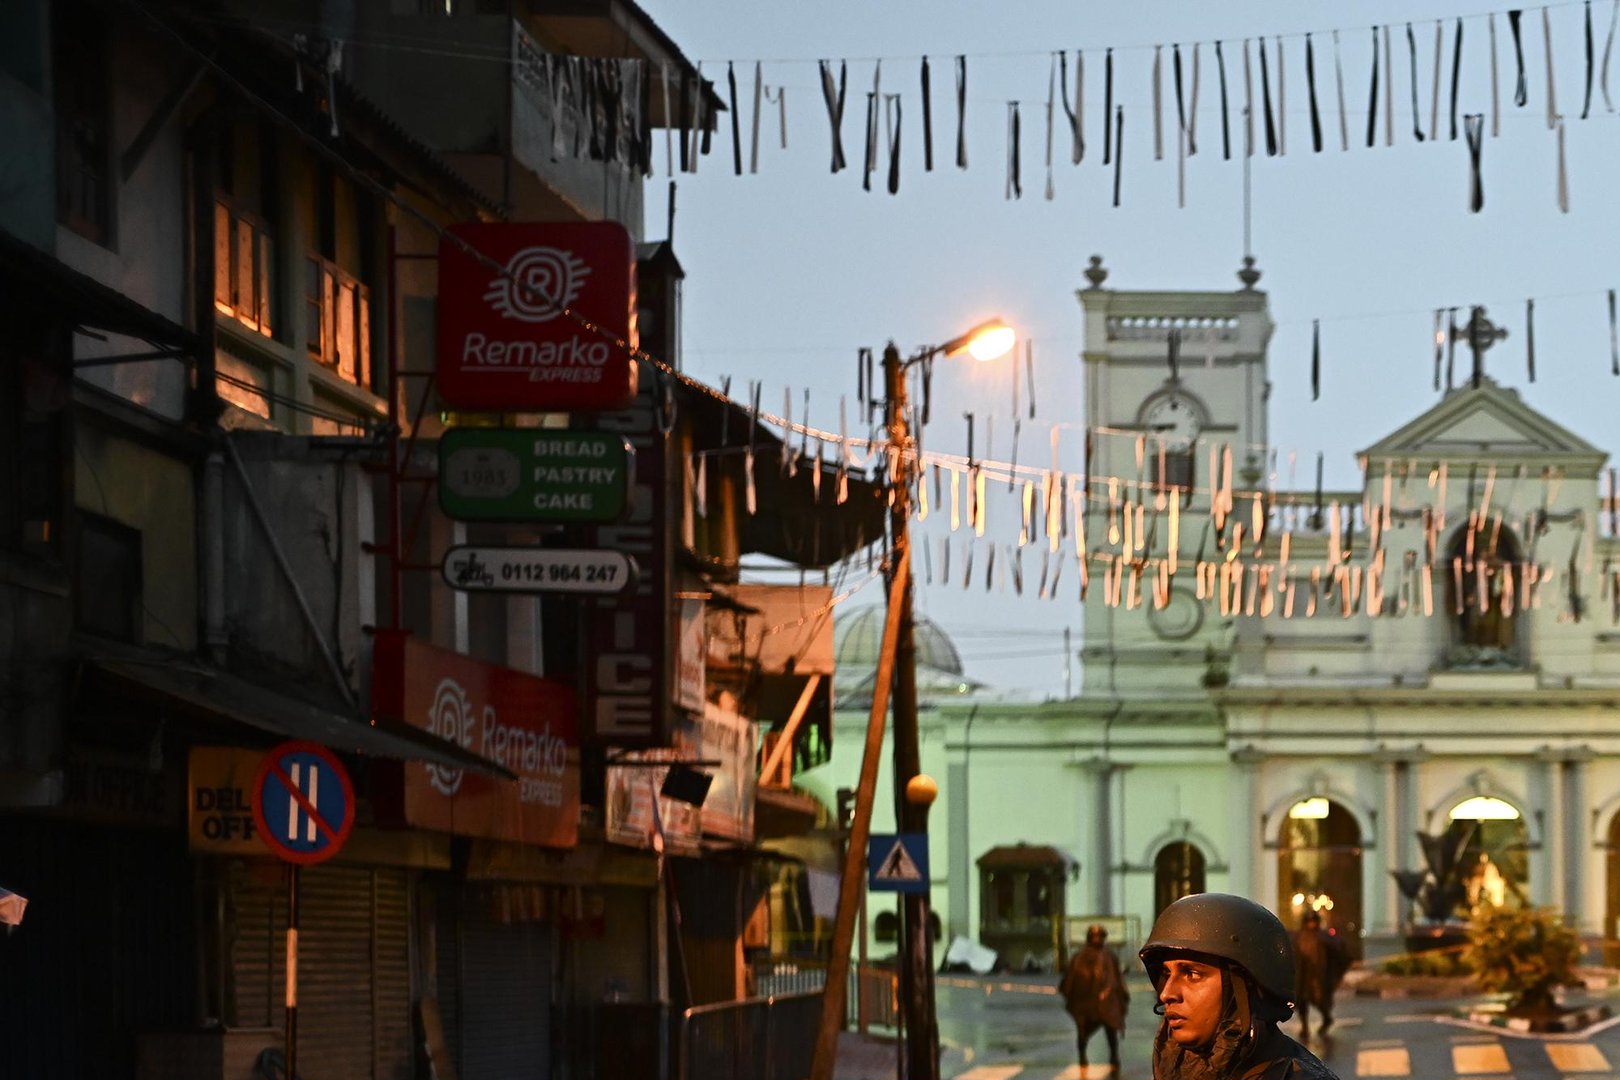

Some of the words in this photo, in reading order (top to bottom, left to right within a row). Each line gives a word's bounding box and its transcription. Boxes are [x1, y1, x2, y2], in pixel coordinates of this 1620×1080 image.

[463, 333, 610, 366] Remarko
[529, 366, 602, 384] EXPRESS
[534, 441, 606, 458] BREAD
[534, 468, 616, 484] PASTRY
[534, 494, 593, 510] CAKE
[502, 564, 545, 582] 0112
[549, 564, 582, 582] 964
[586, 564, 618, 582] 247
[481, 705, 566, 777] Remarko
[520, 777, 562, 807] EXPRESS
